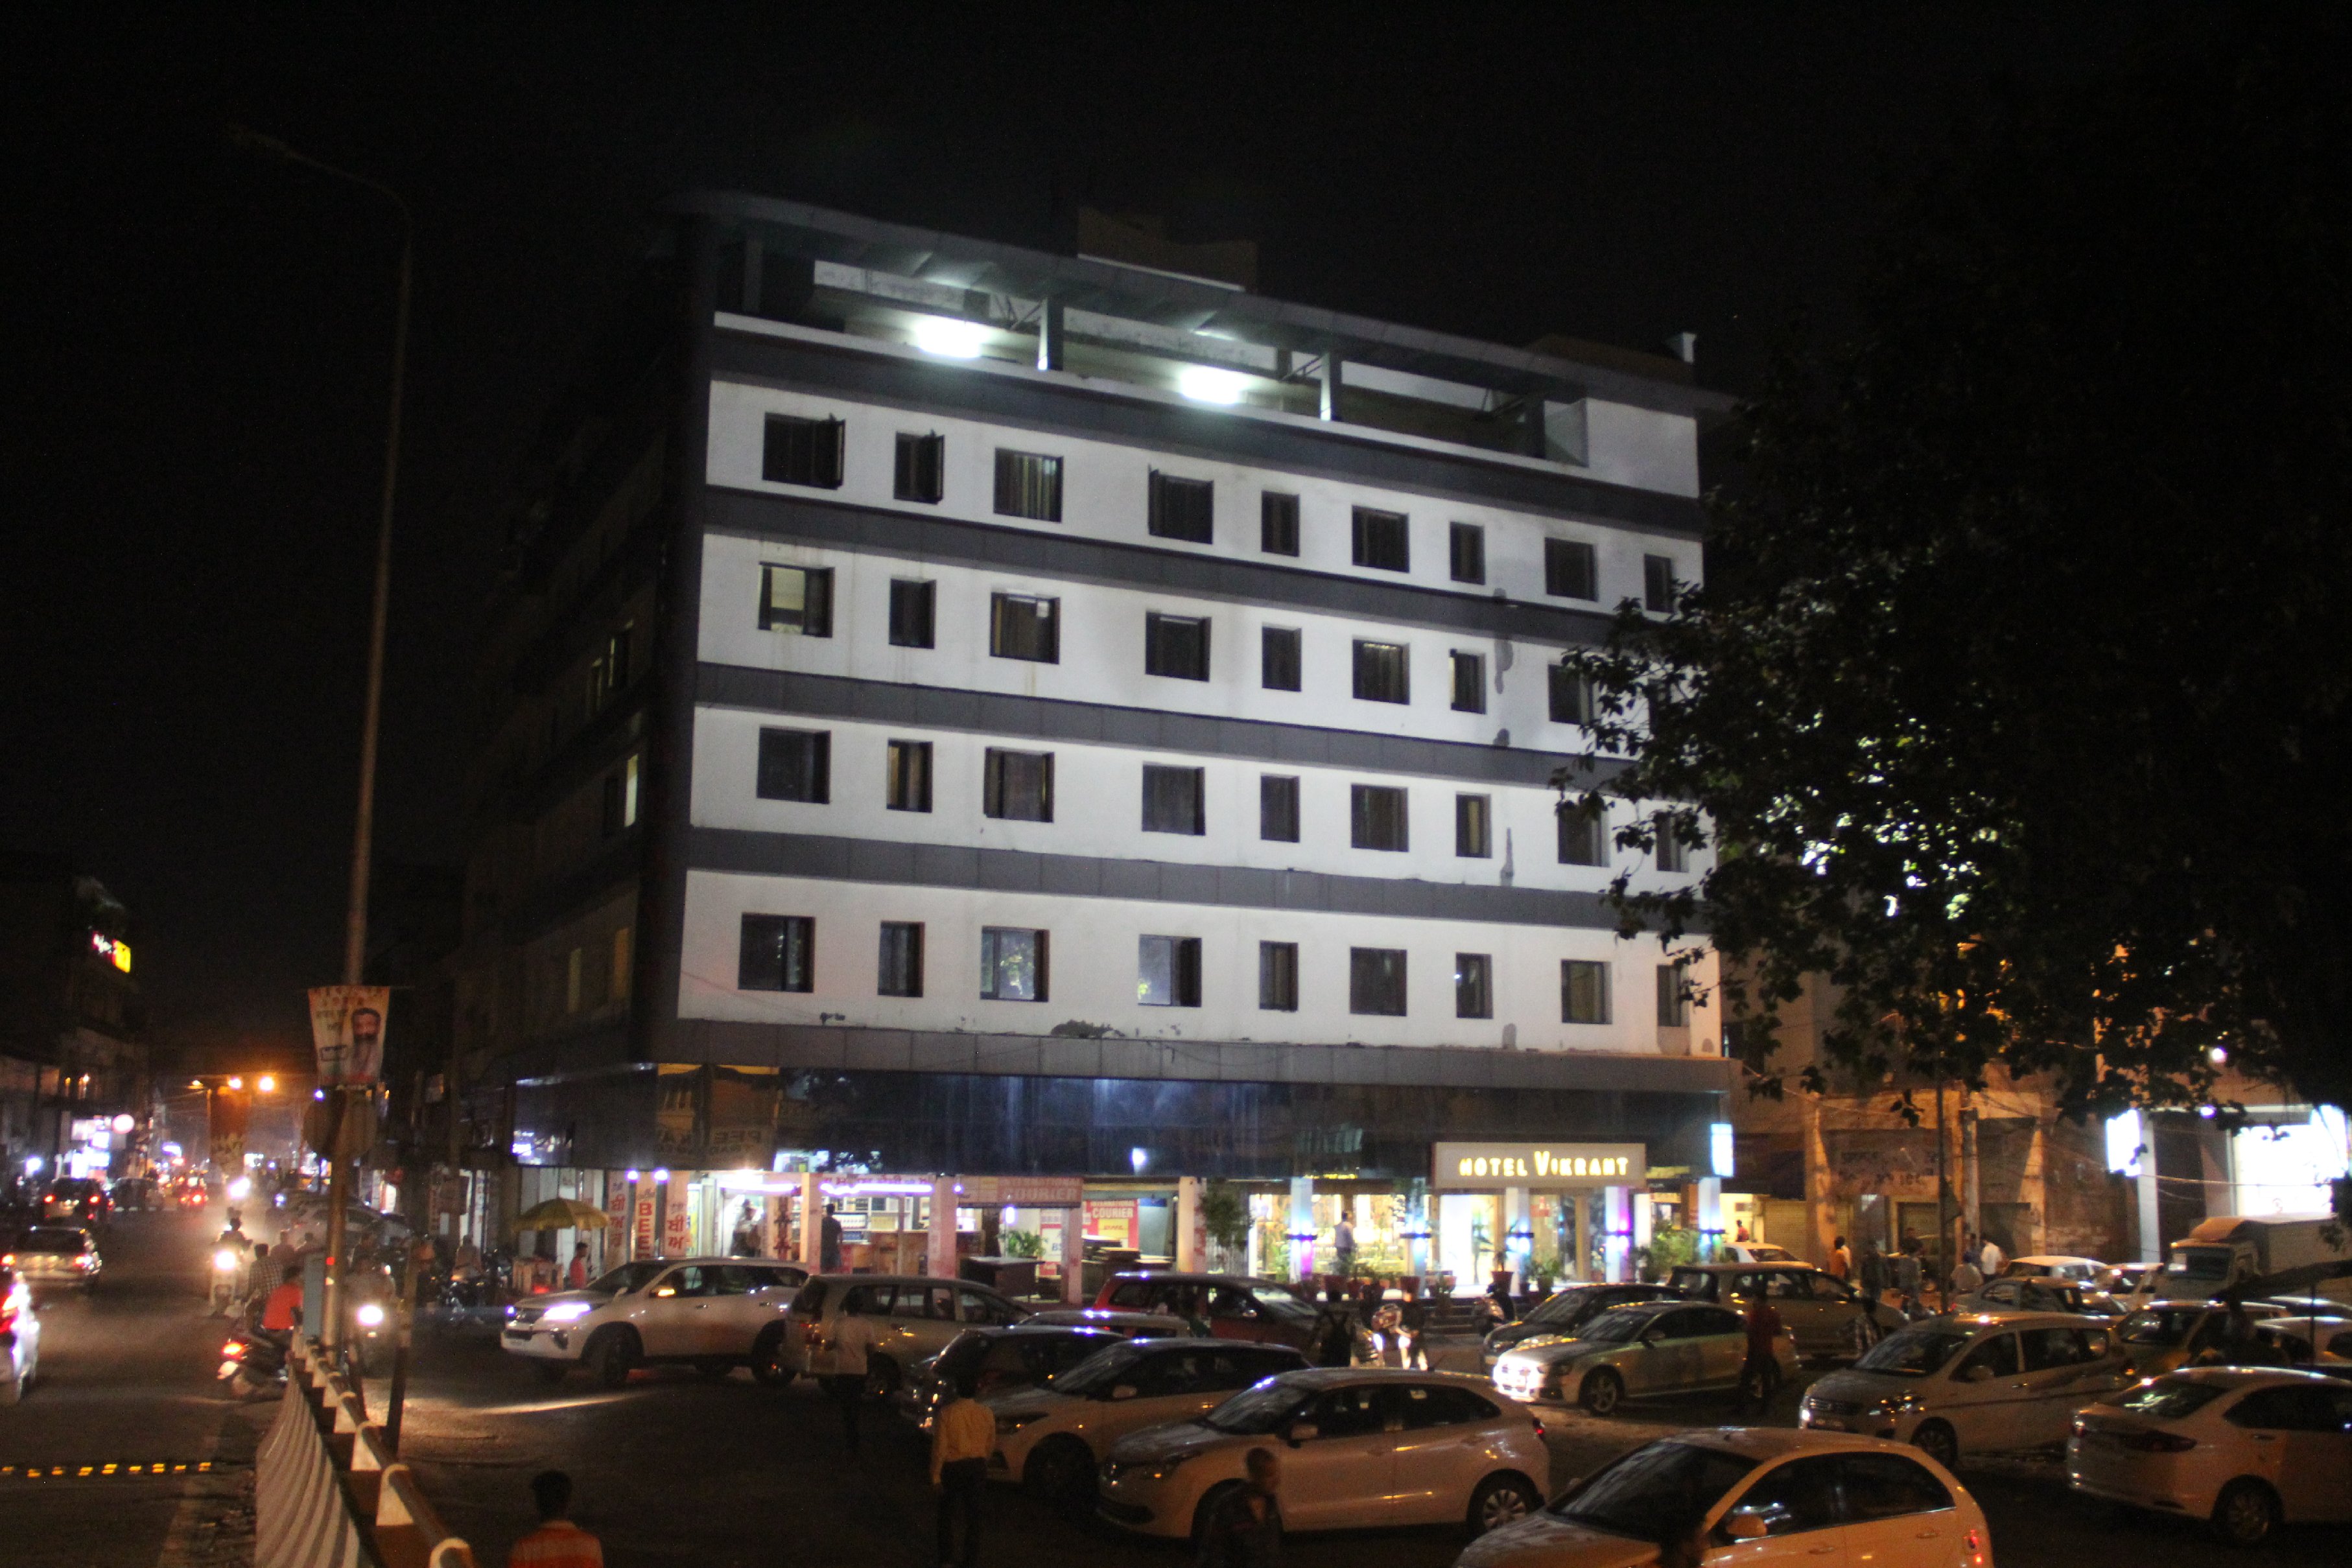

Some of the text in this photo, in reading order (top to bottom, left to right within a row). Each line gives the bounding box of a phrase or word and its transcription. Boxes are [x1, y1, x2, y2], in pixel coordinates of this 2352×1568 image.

[1459, 1151, 1628, 1176] HOTEL VIKRANT
[1002, 1188, 1077, 1201] COURIER
[1092, 1208, 1133, 1219] COURIER
